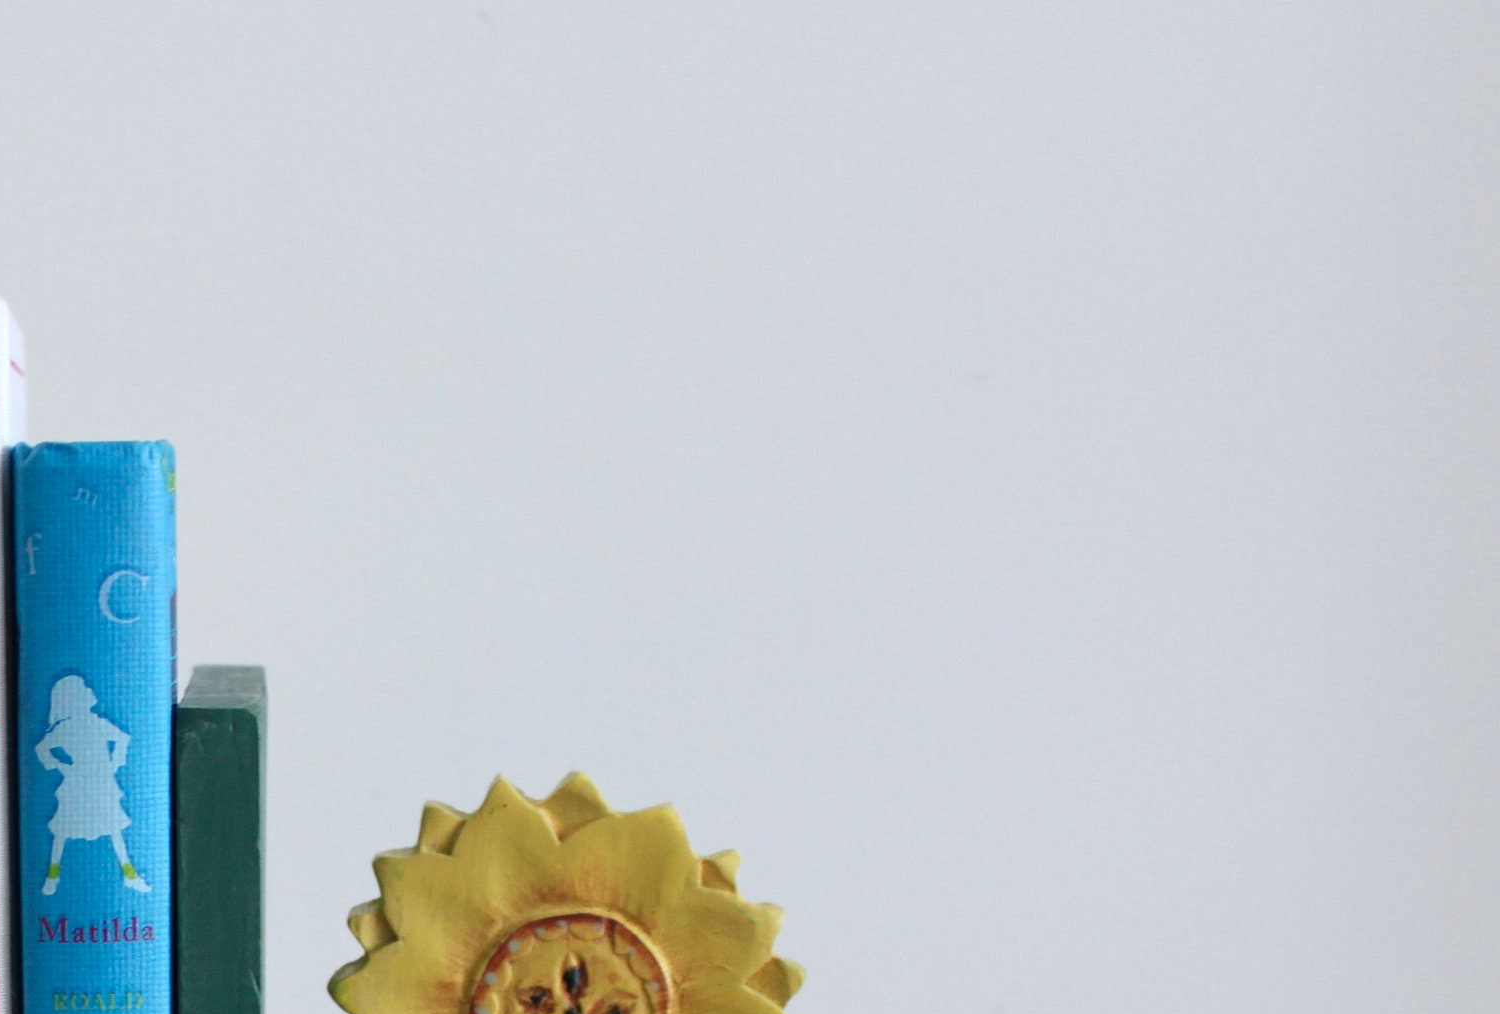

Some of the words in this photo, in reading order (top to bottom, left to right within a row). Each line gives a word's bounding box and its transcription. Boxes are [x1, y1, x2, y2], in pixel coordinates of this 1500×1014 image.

[26, 532, 43, 576] f
[98, 569, 150, 624] C
[37, 917, 156, 943] Matilda
[52, 992, 145, 1011] ROALD
